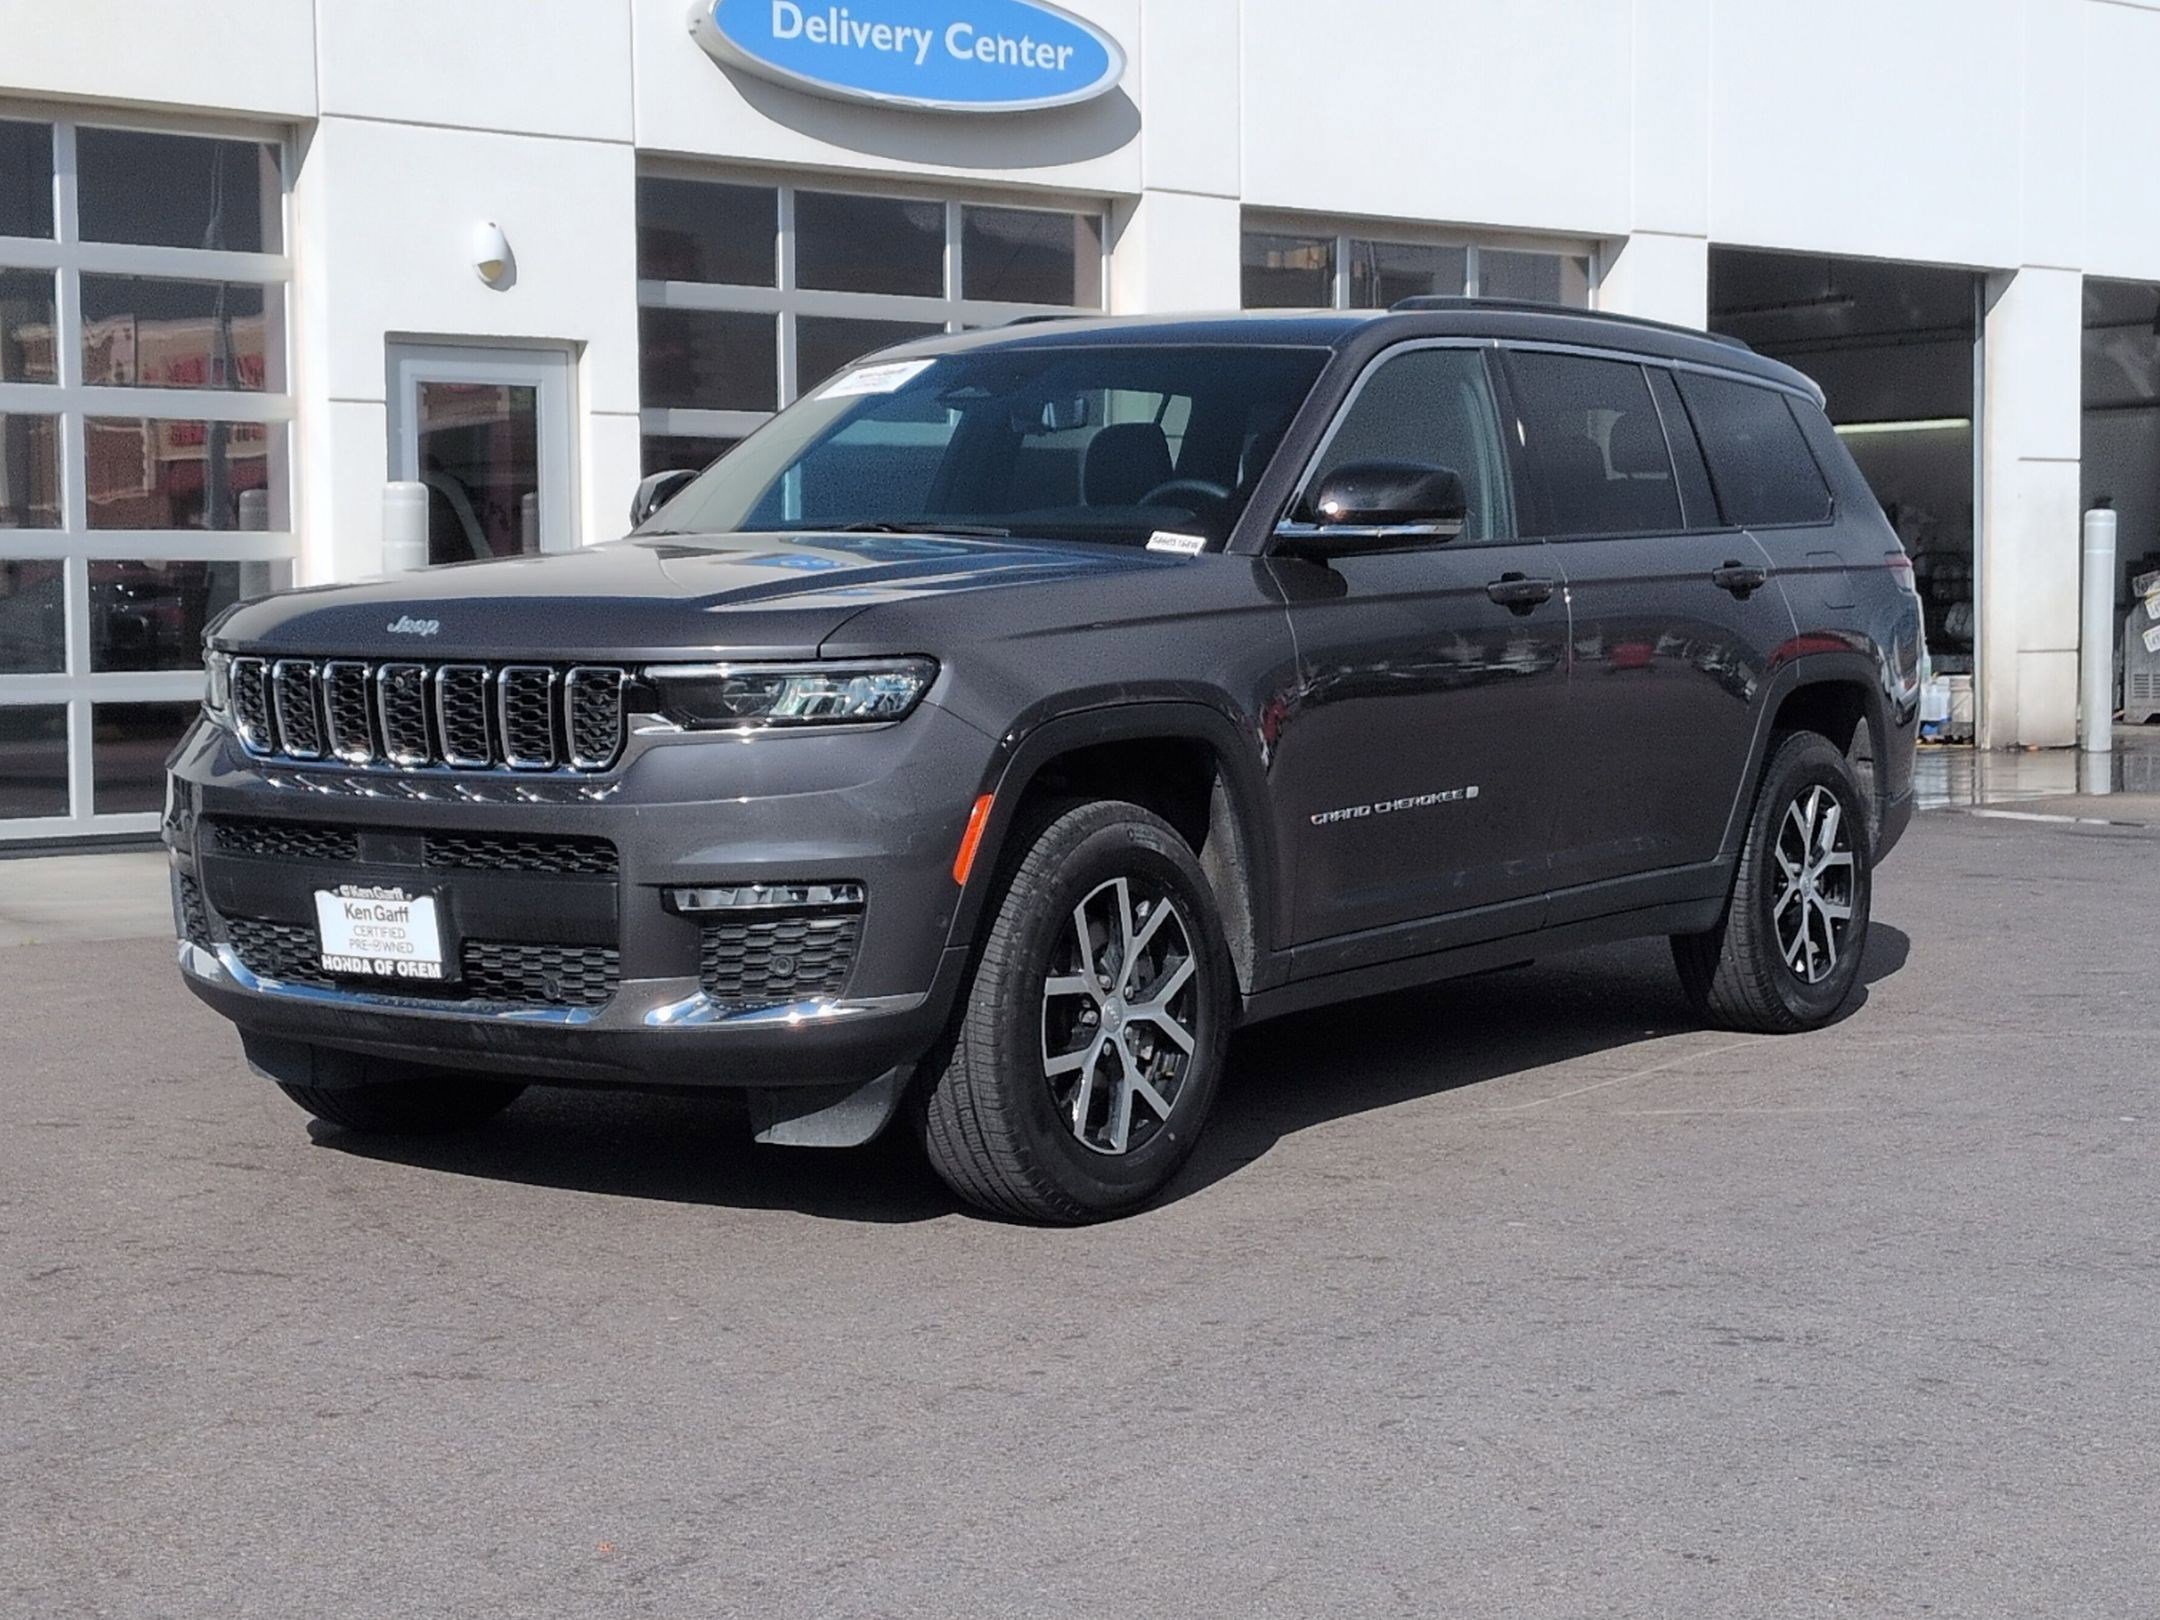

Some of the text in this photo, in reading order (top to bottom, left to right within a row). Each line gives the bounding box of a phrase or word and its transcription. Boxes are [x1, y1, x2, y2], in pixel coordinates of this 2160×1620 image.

[771, 1, 1074, 71] Delivery Center
[387, 615, 439, 636] Jeep
[1311, 789, 1464, 825] GRAND CHEROKEE
[344, 902, 409, 923] Ken Garff
[353, 925, 406, 940] CERTIFIED
[349, 939, 415, 955] PRE-OWNED
[321, 955, 442, 979] HONDA OF OREM
